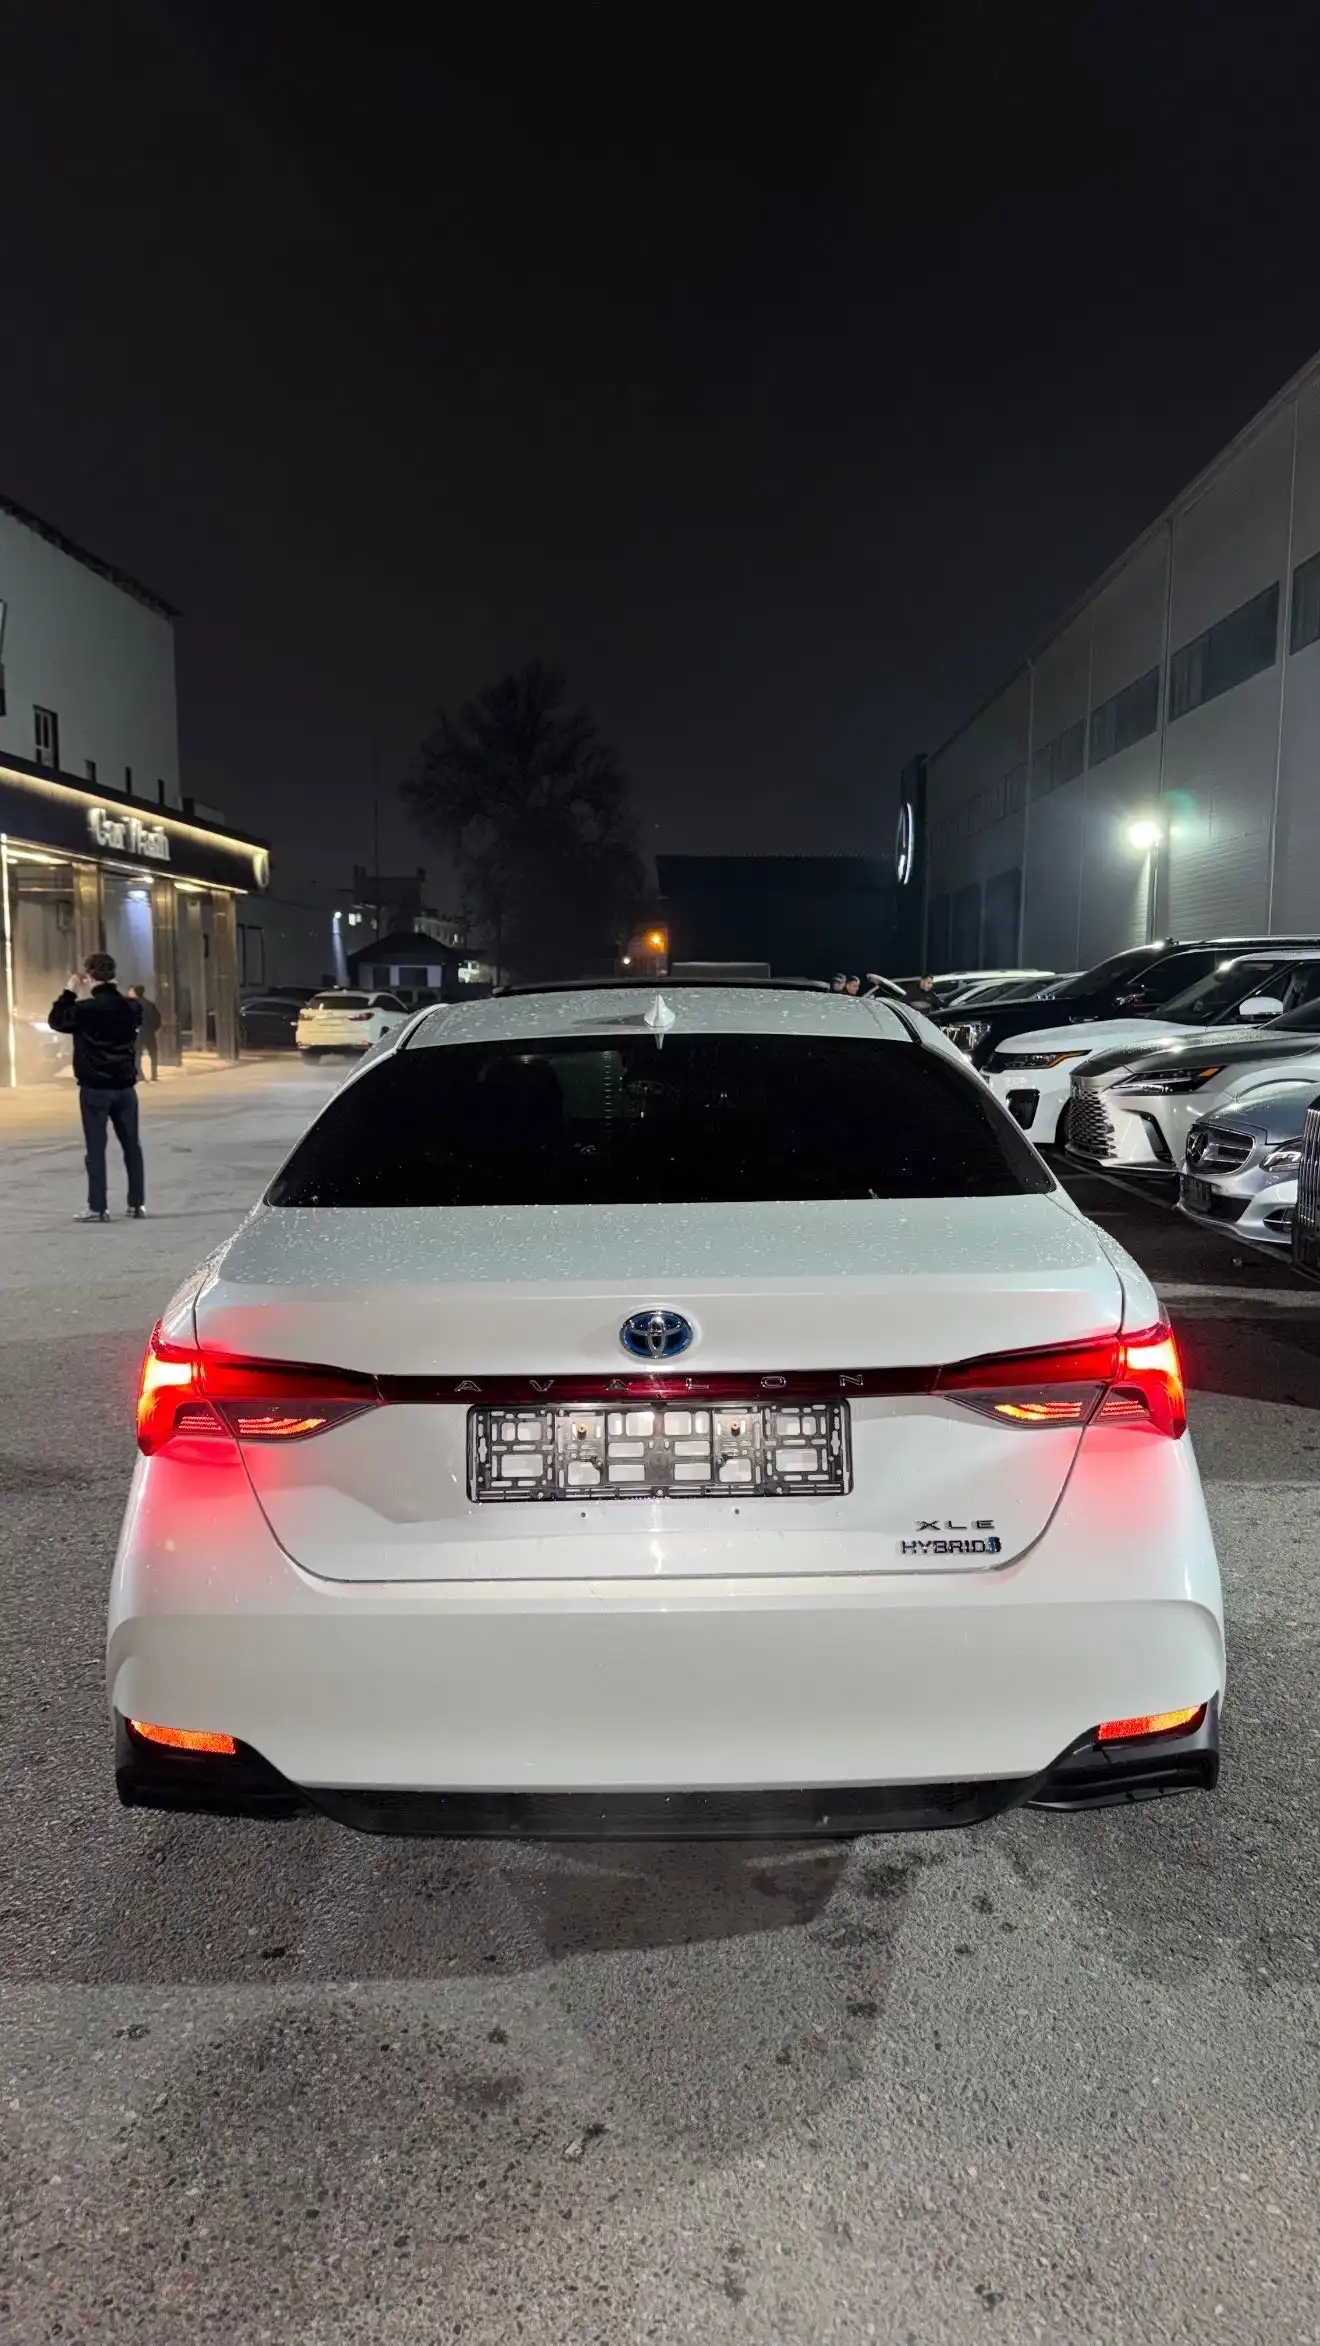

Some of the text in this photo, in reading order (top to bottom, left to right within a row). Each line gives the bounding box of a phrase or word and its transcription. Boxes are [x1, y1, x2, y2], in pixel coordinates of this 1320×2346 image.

[88, 808, 124, 849] Car
[454, 1374, 864, 1392] AVALON
[916, 1519, 995, 1532] XLE
[901, 1539, 985, 1554] HYBRID
